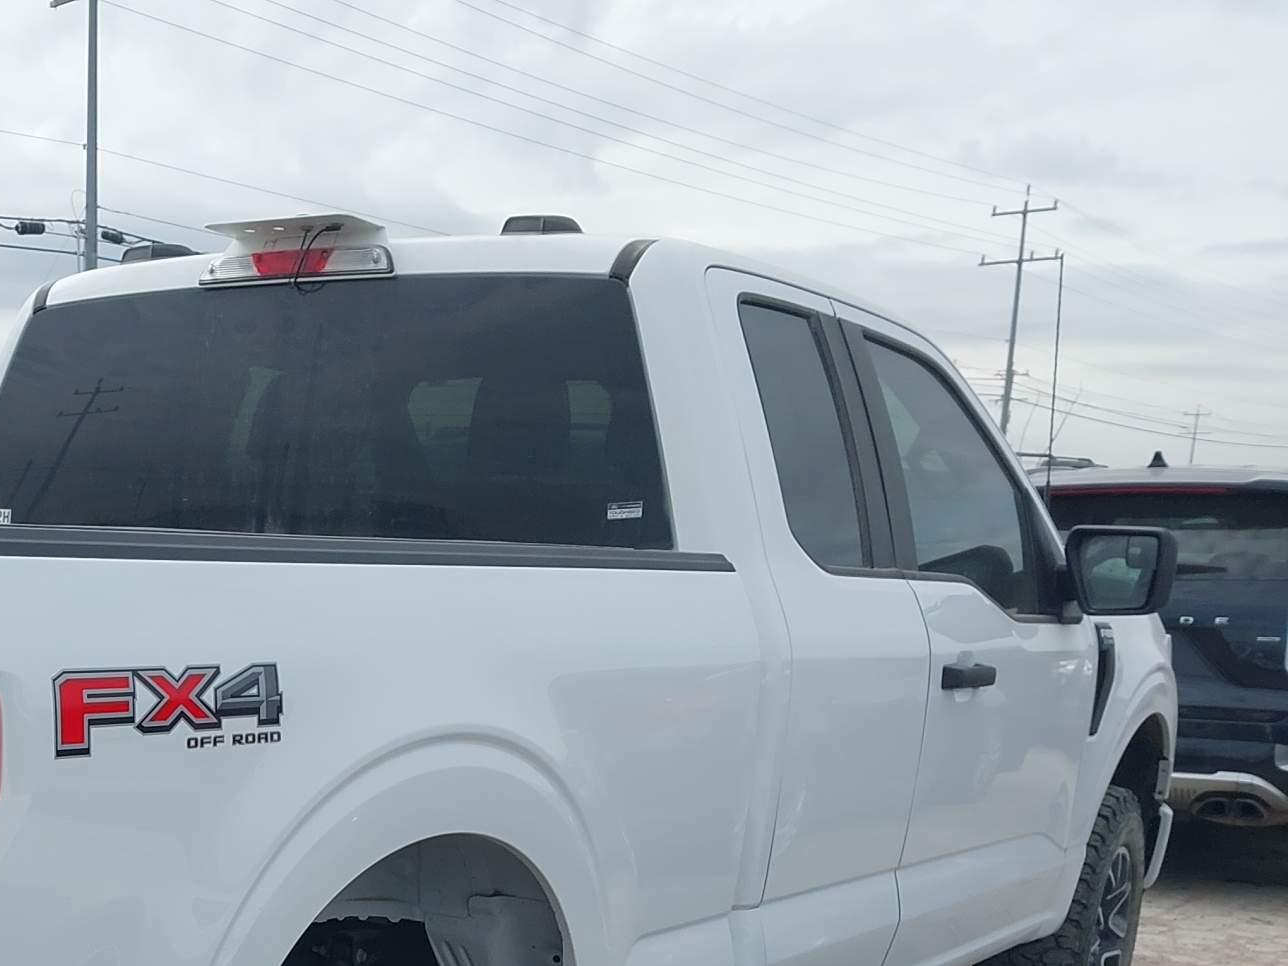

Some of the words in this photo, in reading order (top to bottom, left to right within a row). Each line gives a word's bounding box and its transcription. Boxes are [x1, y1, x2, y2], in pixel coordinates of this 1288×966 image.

[52, 662, 283, 759] FX4
[186, 735, 225, 749] OFF
[231, 731, 282, 746] ROAD
